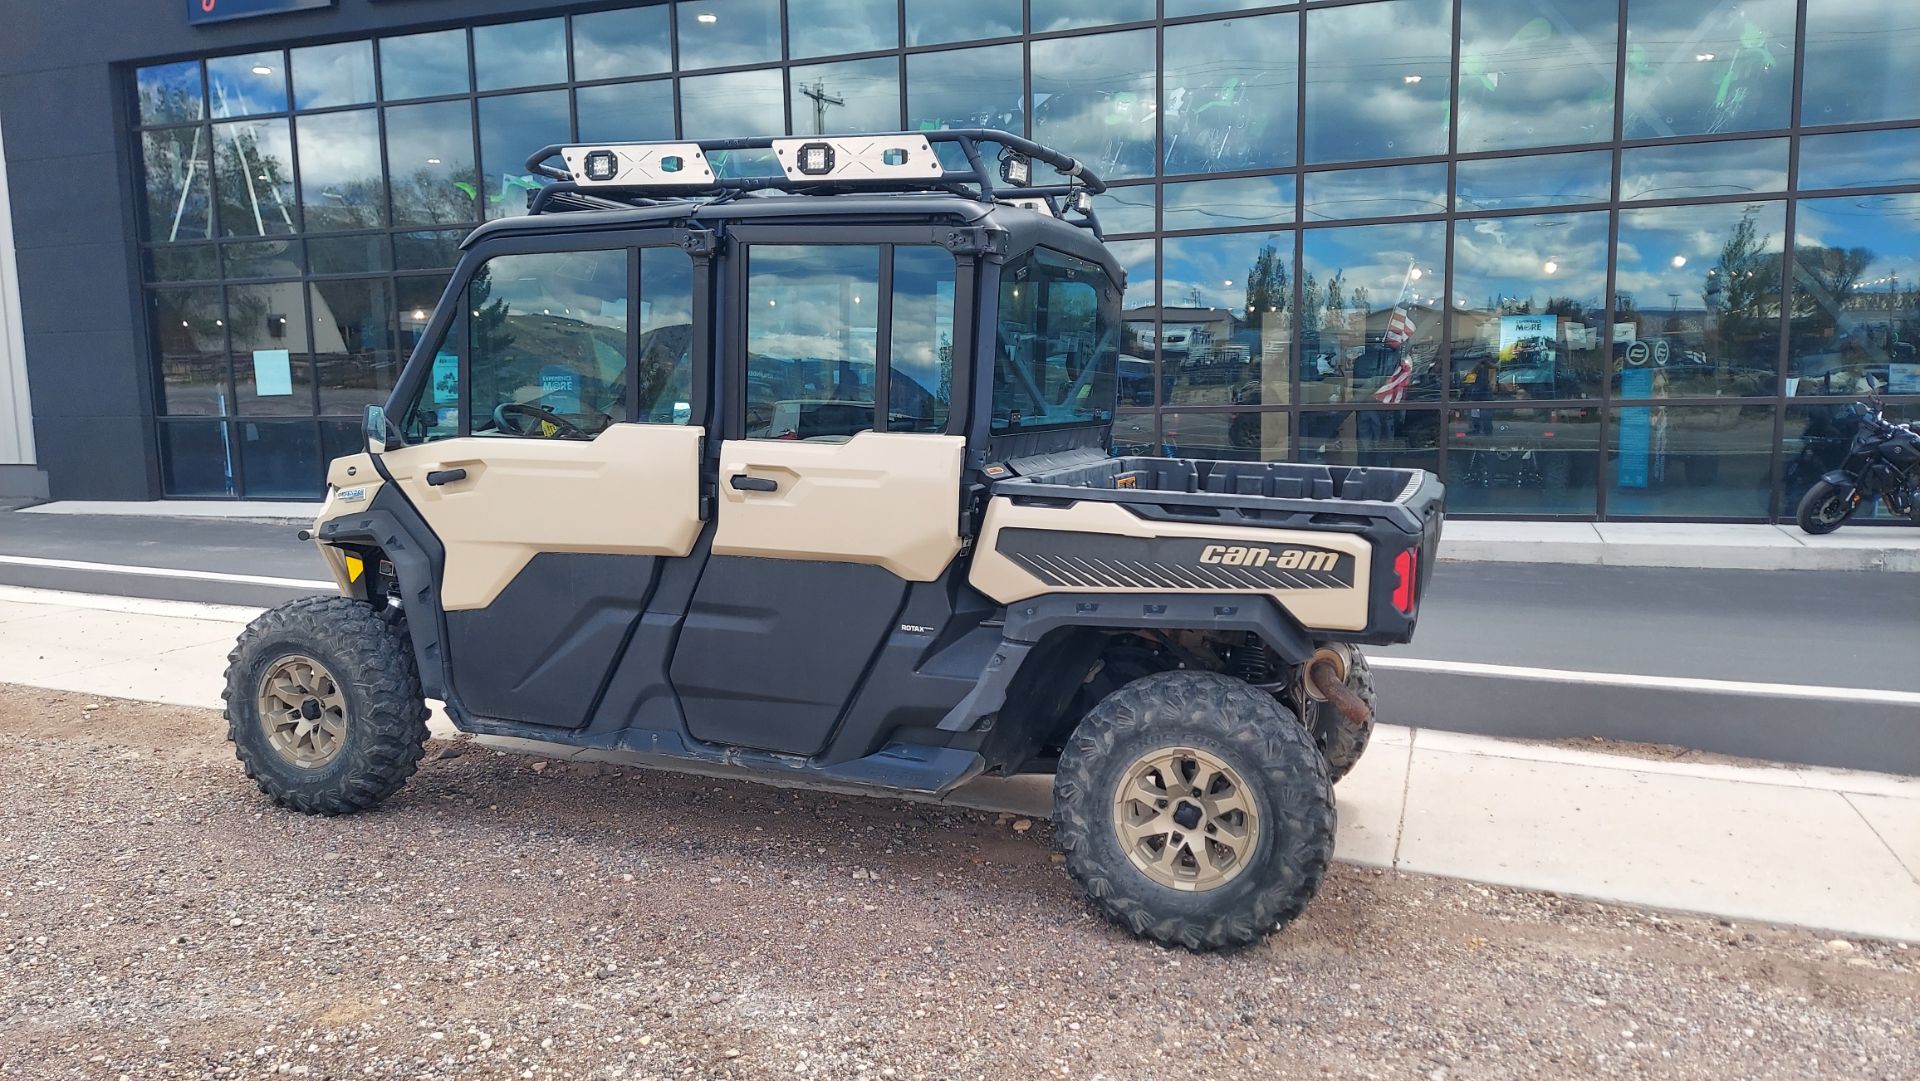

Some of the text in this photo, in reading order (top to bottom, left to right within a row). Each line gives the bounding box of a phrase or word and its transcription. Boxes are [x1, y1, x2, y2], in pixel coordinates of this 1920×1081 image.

[543, 381, 573, 391] MORE
[1199, 544, 1340, 572] can-am
[901, 624, 925, 633] ROTAX
